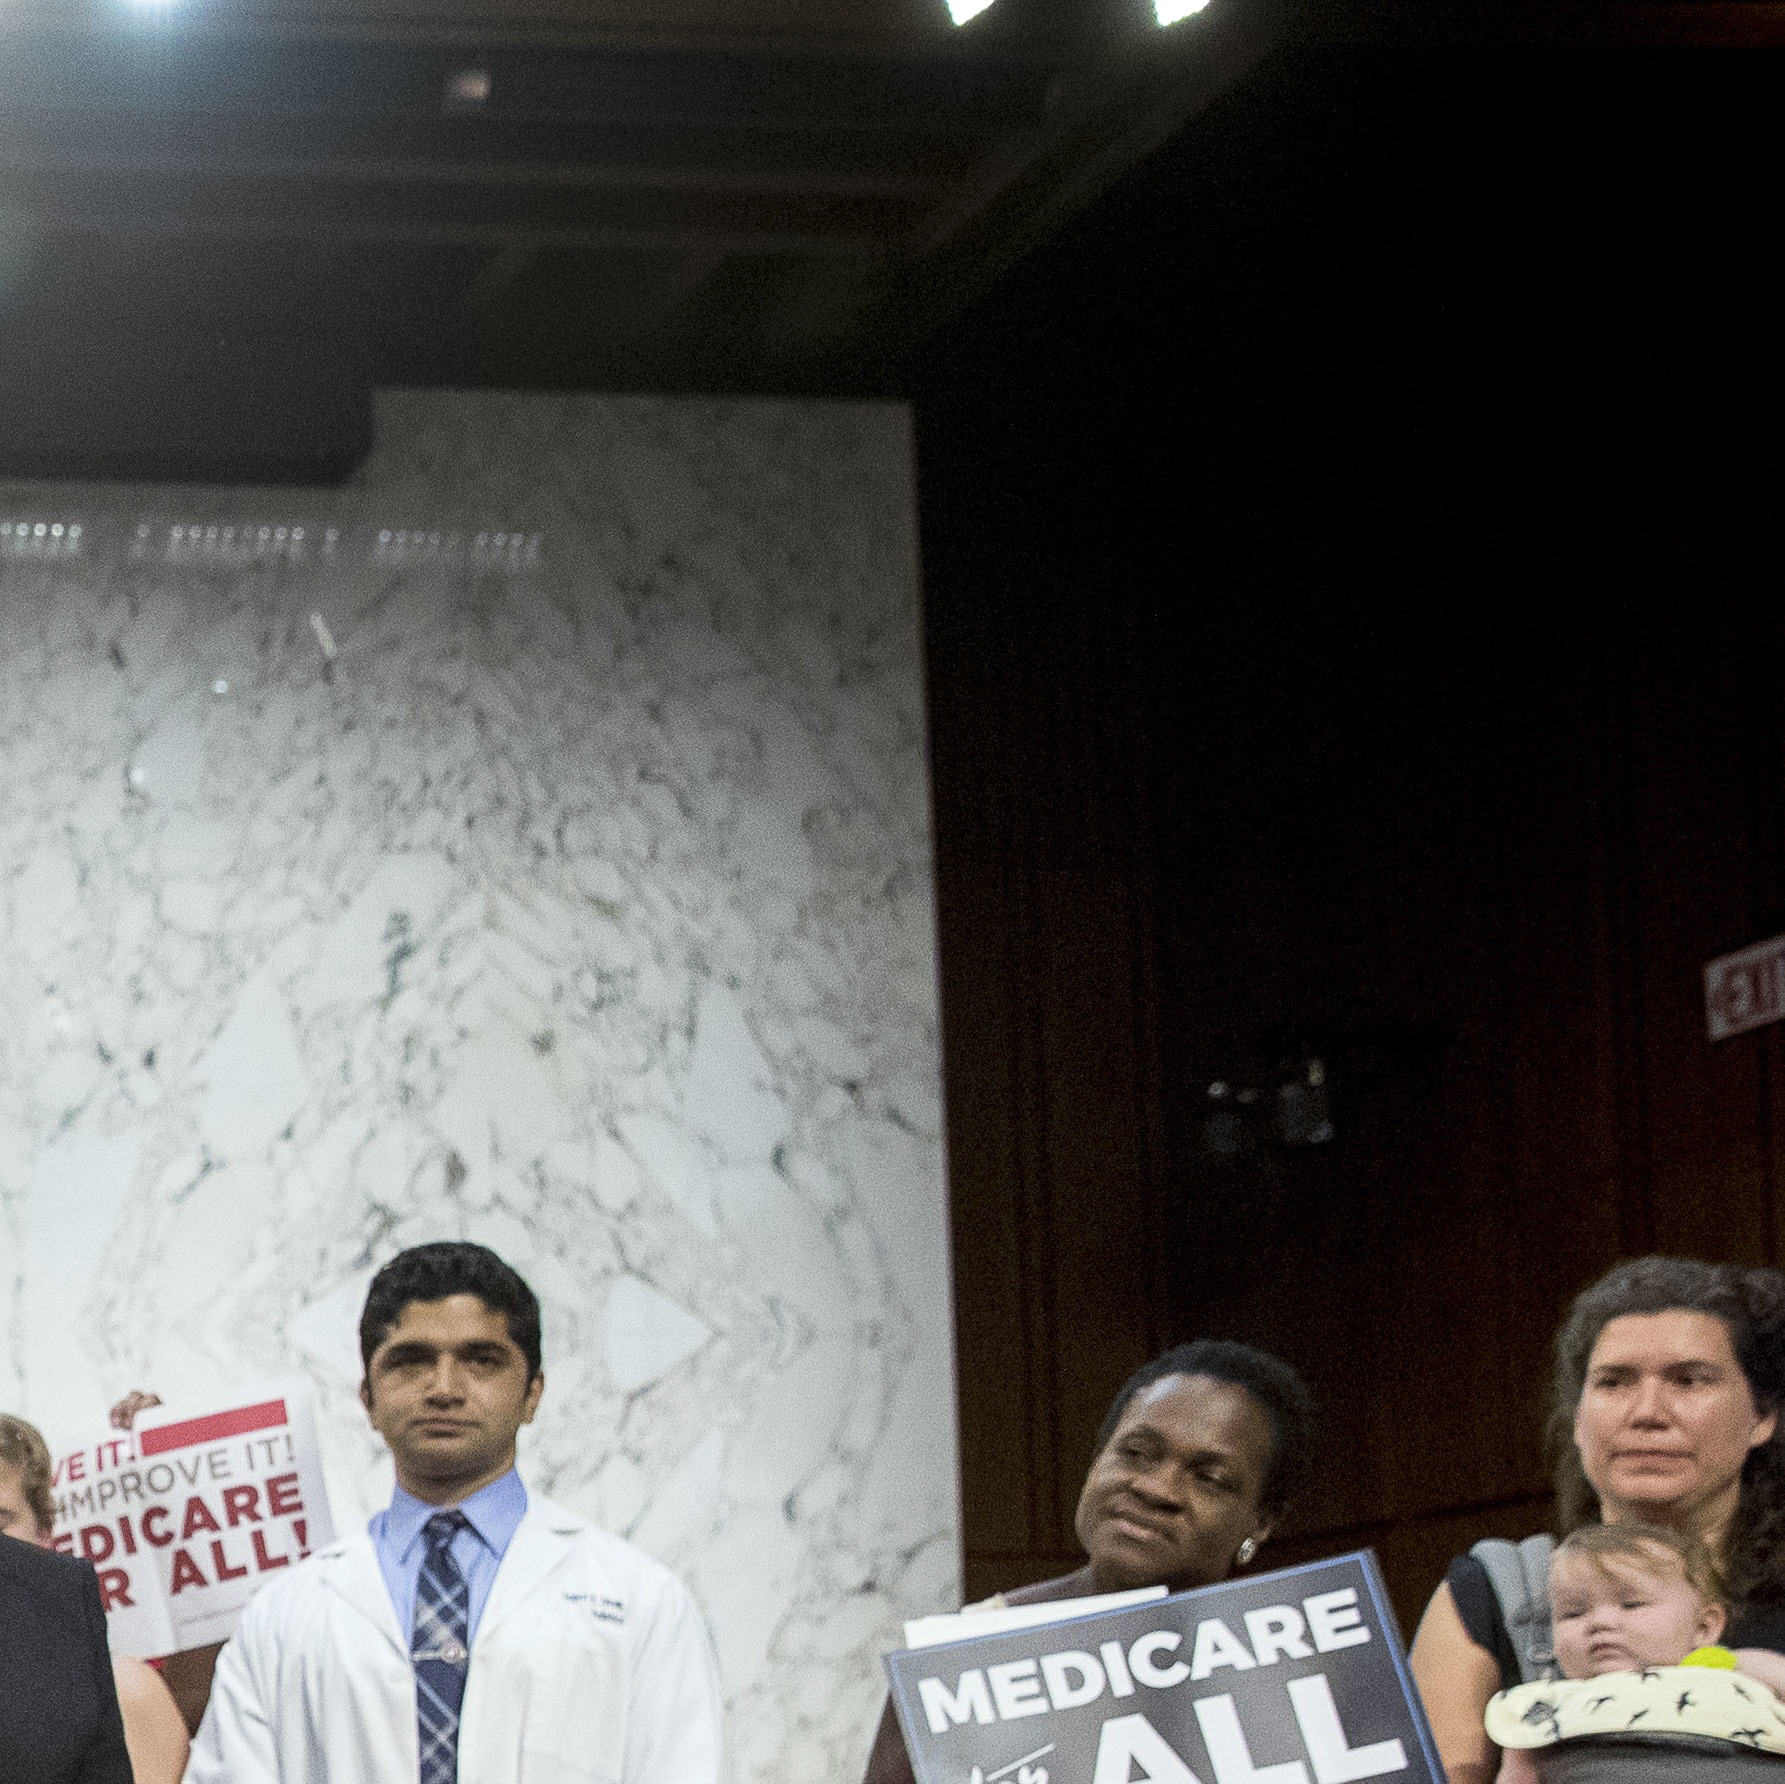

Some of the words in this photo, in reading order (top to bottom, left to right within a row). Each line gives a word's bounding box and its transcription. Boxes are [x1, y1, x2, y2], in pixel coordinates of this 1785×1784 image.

[52, 1472, 304, 1562] EDICARE
[56, 1447, 232, 1521] IMPROVE
[246, 1433, 296, 1471] IT!
[171, 1519, 312, 1596] ALL!
[917, 1587, 1371, 1734] MEDICARE
